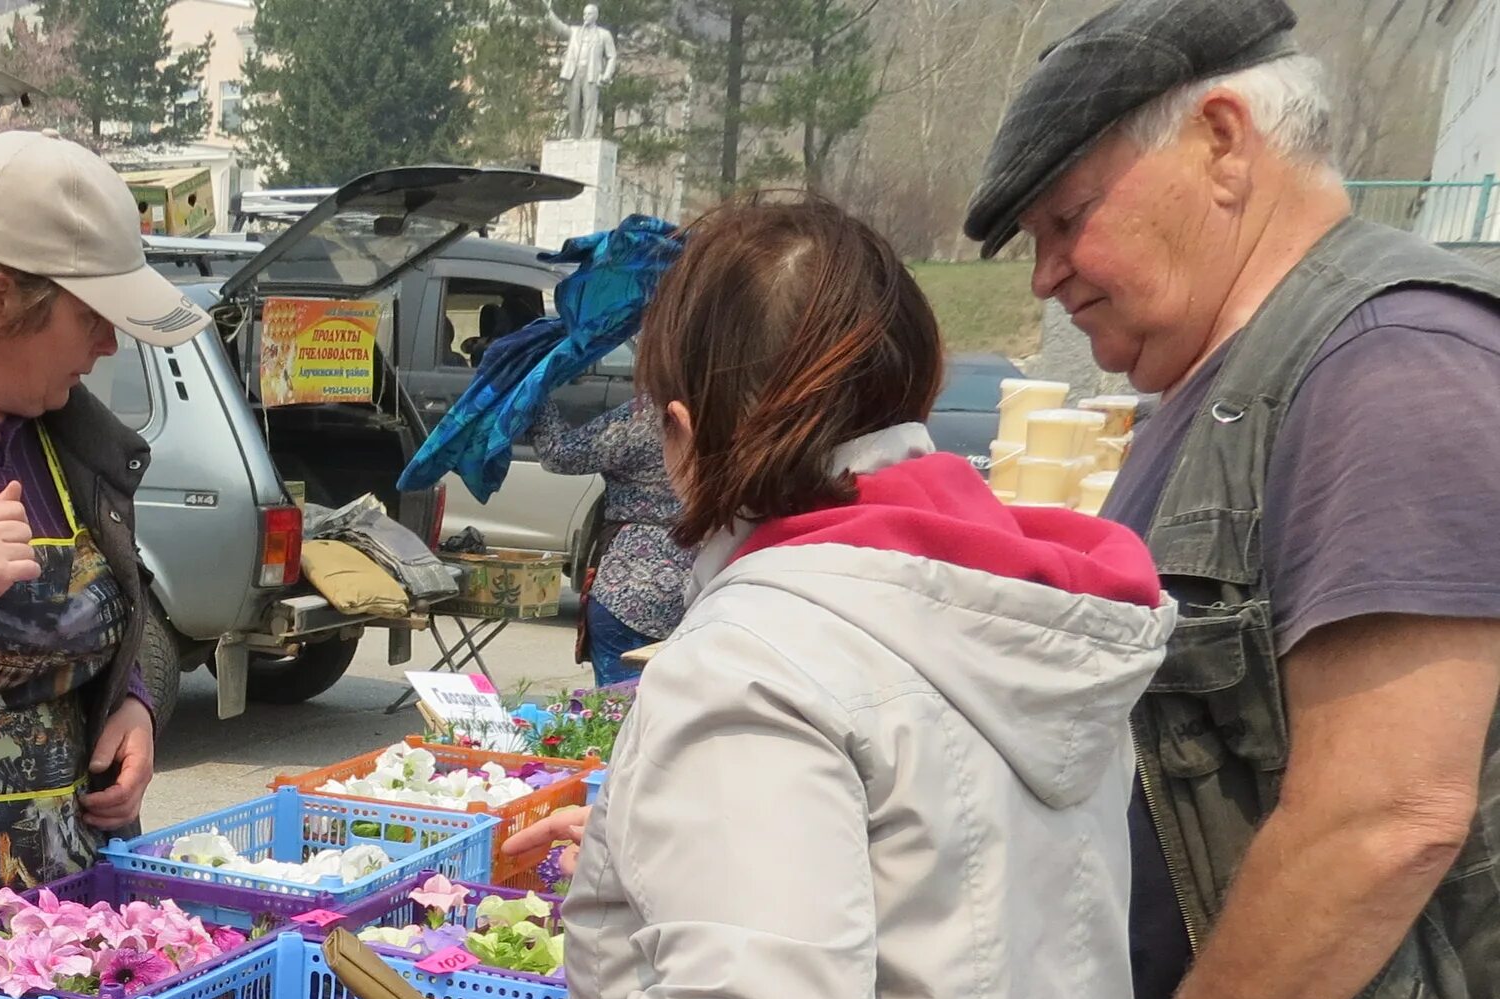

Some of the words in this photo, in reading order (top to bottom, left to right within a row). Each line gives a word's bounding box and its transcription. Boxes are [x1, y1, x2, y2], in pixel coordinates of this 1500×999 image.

[312, 329, 361, 343] ПРОДУКТЫ
[298, 347, 369, 361] ПЧЕЛОВОДСТВА
[431, 687, 492, 708] Гвоздика
